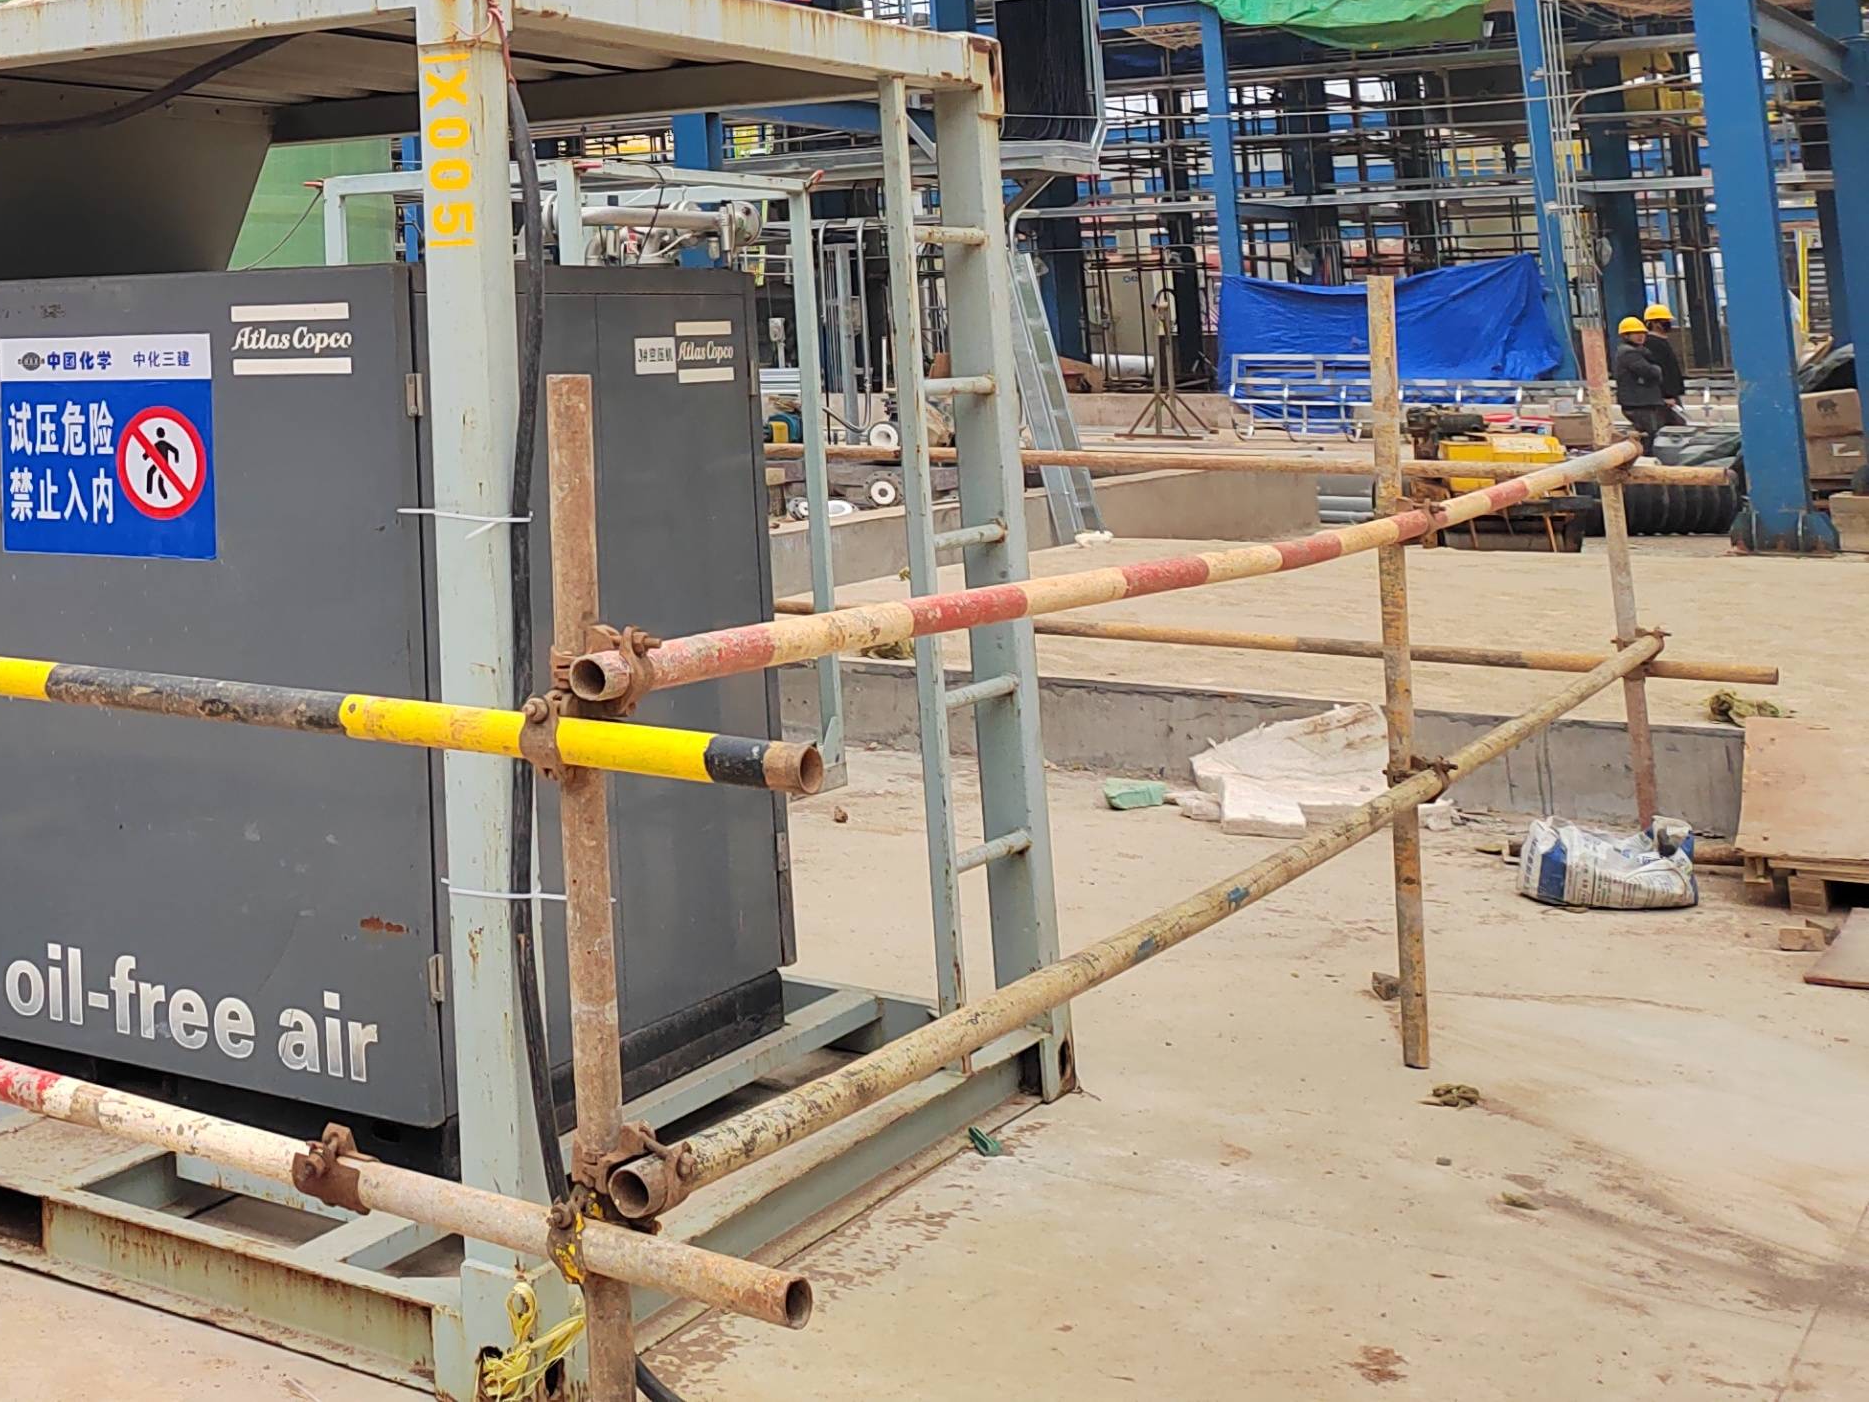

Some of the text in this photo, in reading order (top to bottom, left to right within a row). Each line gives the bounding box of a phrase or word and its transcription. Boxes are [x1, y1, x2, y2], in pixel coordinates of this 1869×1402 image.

[47, 351, 112, 370] 中国化学
[133, 350, 191, 368] 中化三建
[231, 326, 352, 353] Atlas Copco
[678, 341, 734, 364] Atlas Copco
[8, 400, 114, 456] 试压危险
[9, 467, 114, 524] 禁止入内
[5, 942, 379, 1083] oil-free air
